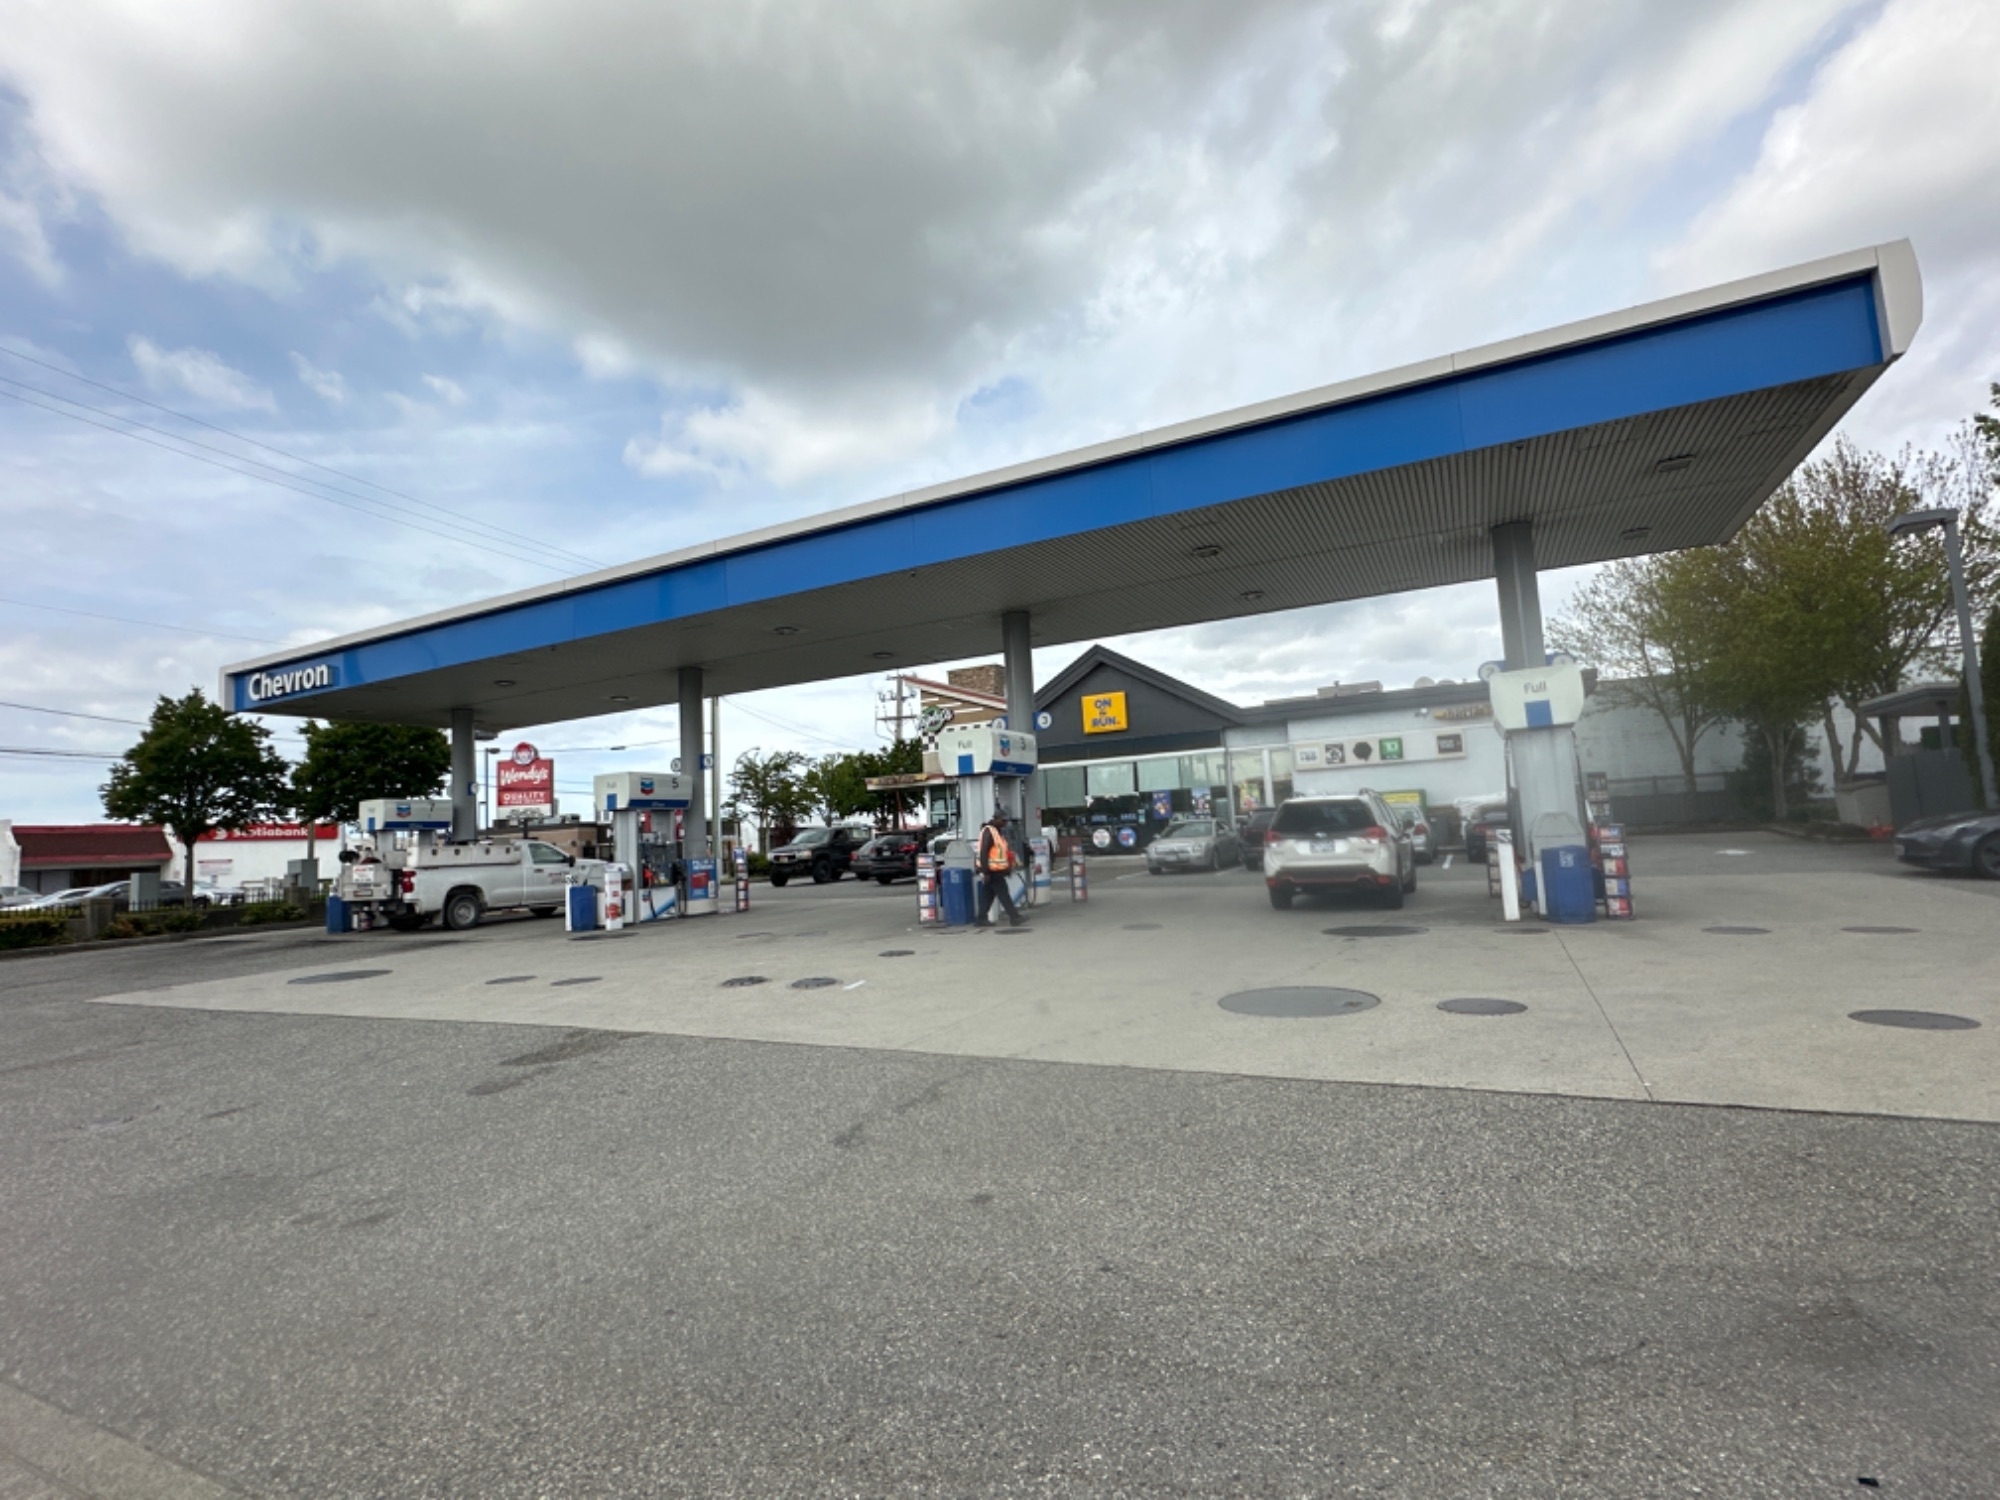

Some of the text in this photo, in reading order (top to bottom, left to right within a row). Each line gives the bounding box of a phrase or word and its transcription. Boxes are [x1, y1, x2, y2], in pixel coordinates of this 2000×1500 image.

[248, 664, 328, 701] Chevron
[1523, 681, 1547, 694] Full
[1094, 698, 1111, 709] ON
[1091, 716, 1116, 727] RUN
[500, 765, 549, 786] Wendy's
[672, 777, 680, 789] 5
